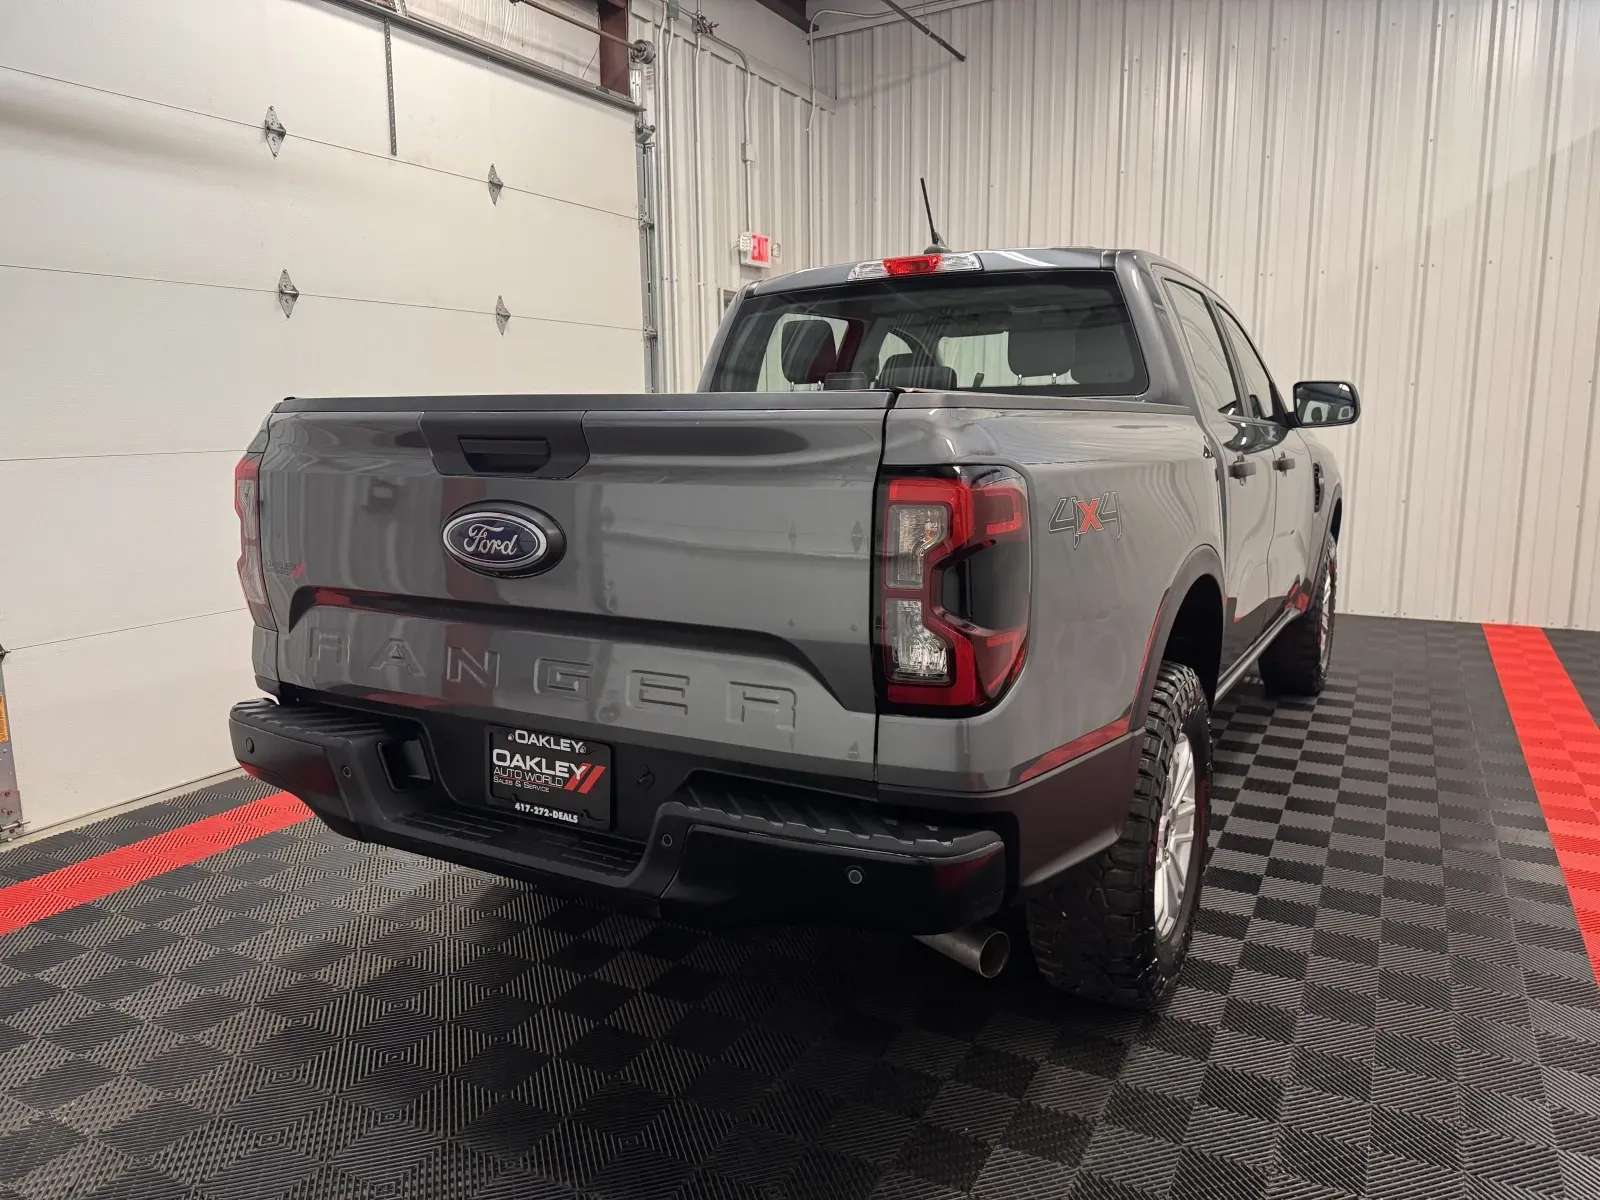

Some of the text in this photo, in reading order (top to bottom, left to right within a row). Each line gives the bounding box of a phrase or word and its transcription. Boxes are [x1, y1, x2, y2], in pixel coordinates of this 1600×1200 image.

[463, 523, 518, 555] Ford
[308, 626, 798, 731] RANGER
[515, 729, 583, 753] OAKLEY
[492, 748, 587, 780] OAKLEY
[493, 766, 564, 787] AUTO WORLD
[515, 780, 522, 788] &
[514, 802, 579, 824] 417-272-DEALS
